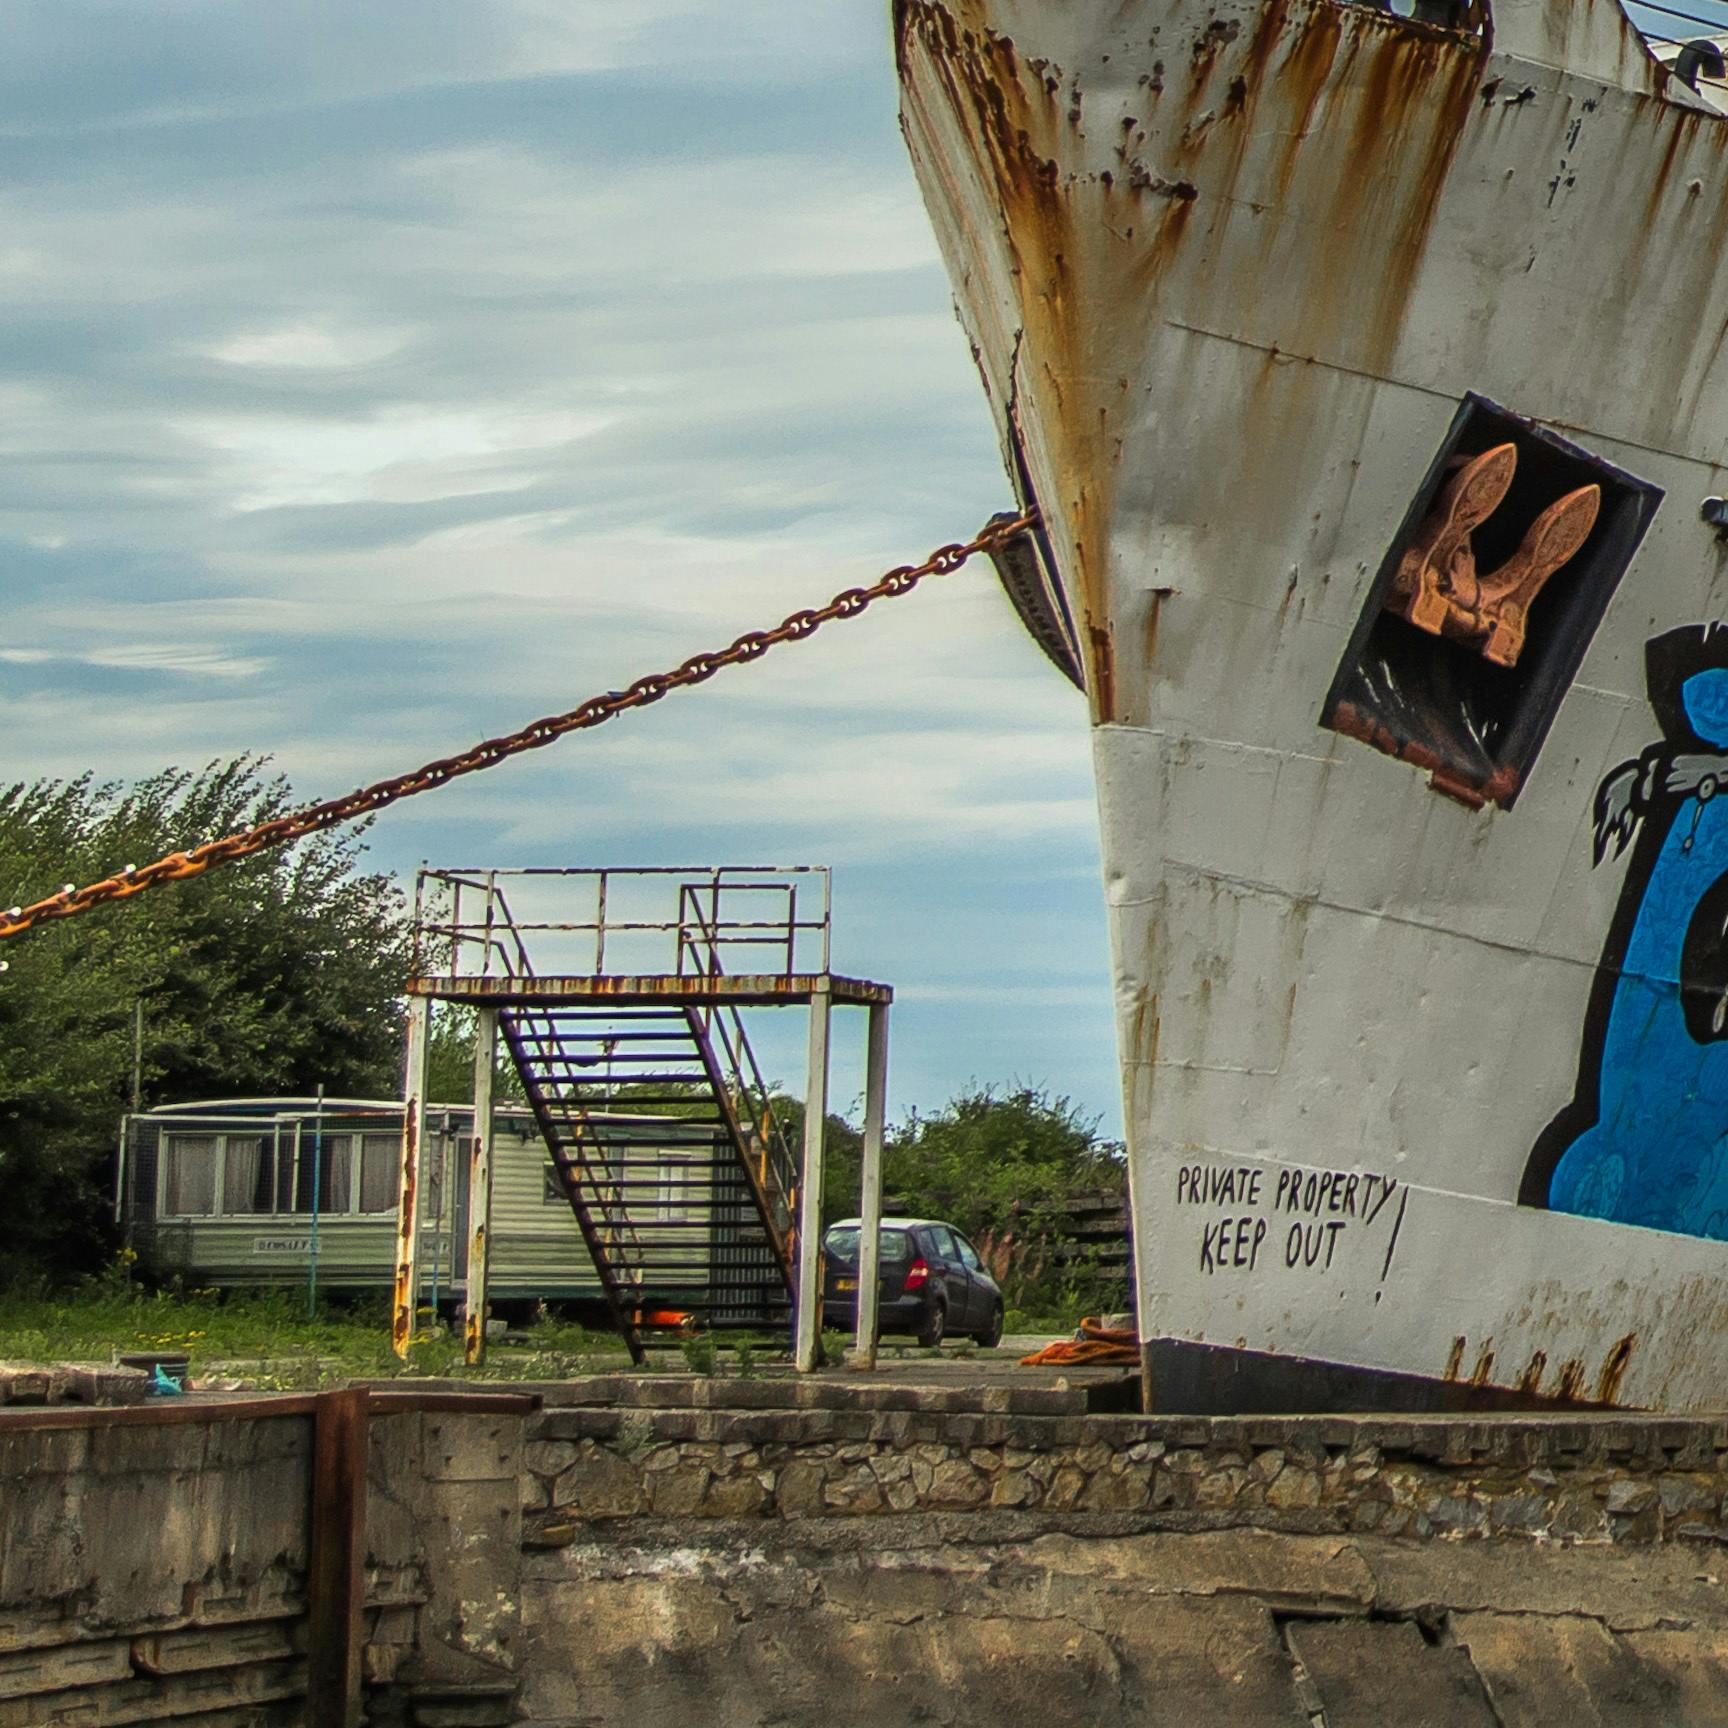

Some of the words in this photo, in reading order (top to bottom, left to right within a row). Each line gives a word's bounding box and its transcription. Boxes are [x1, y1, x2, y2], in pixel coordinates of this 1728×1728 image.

[1177, 1165, 1264, 1207] PRIVATE
[1275, 1168, 1398, 1225] PROPERTY
[1200, 1216, 1267, 1275] KEEP
